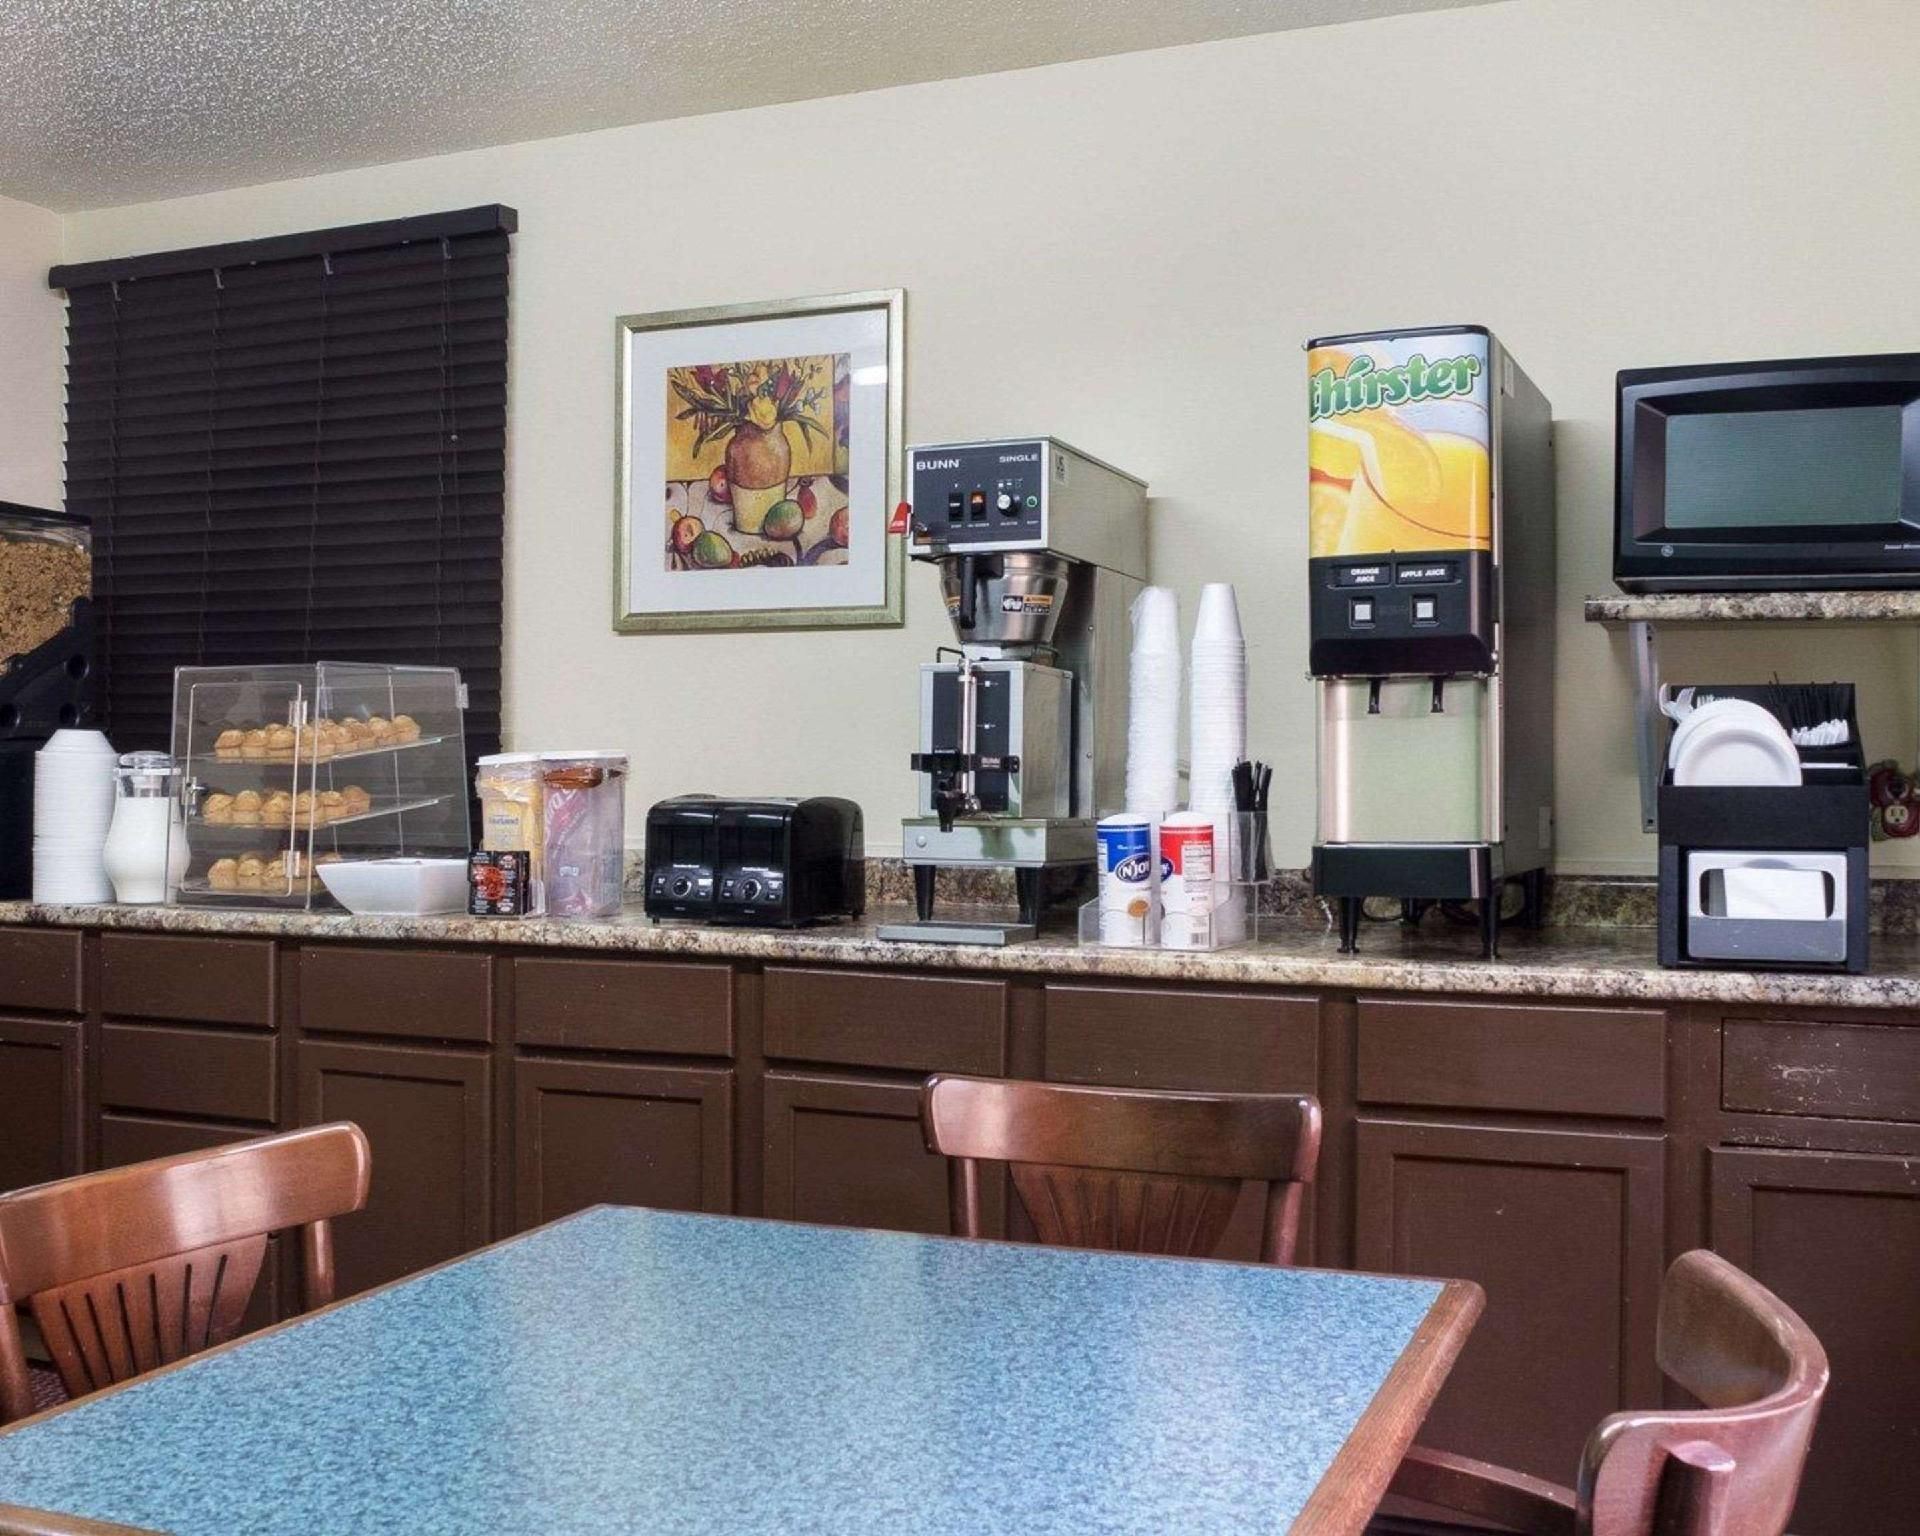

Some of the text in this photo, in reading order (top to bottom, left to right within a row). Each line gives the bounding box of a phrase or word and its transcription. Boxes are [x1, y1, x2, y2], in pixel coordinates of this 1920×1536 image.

[999, 453, 1040, 463] SINGLE
[916, 459, 961, 471] BUNN
[1350, 567, 1380, 576] ORANGE
[1400, 568, 1446, 578] APPLE JUICE
[1355, 575, 1376, 584] JUICE
